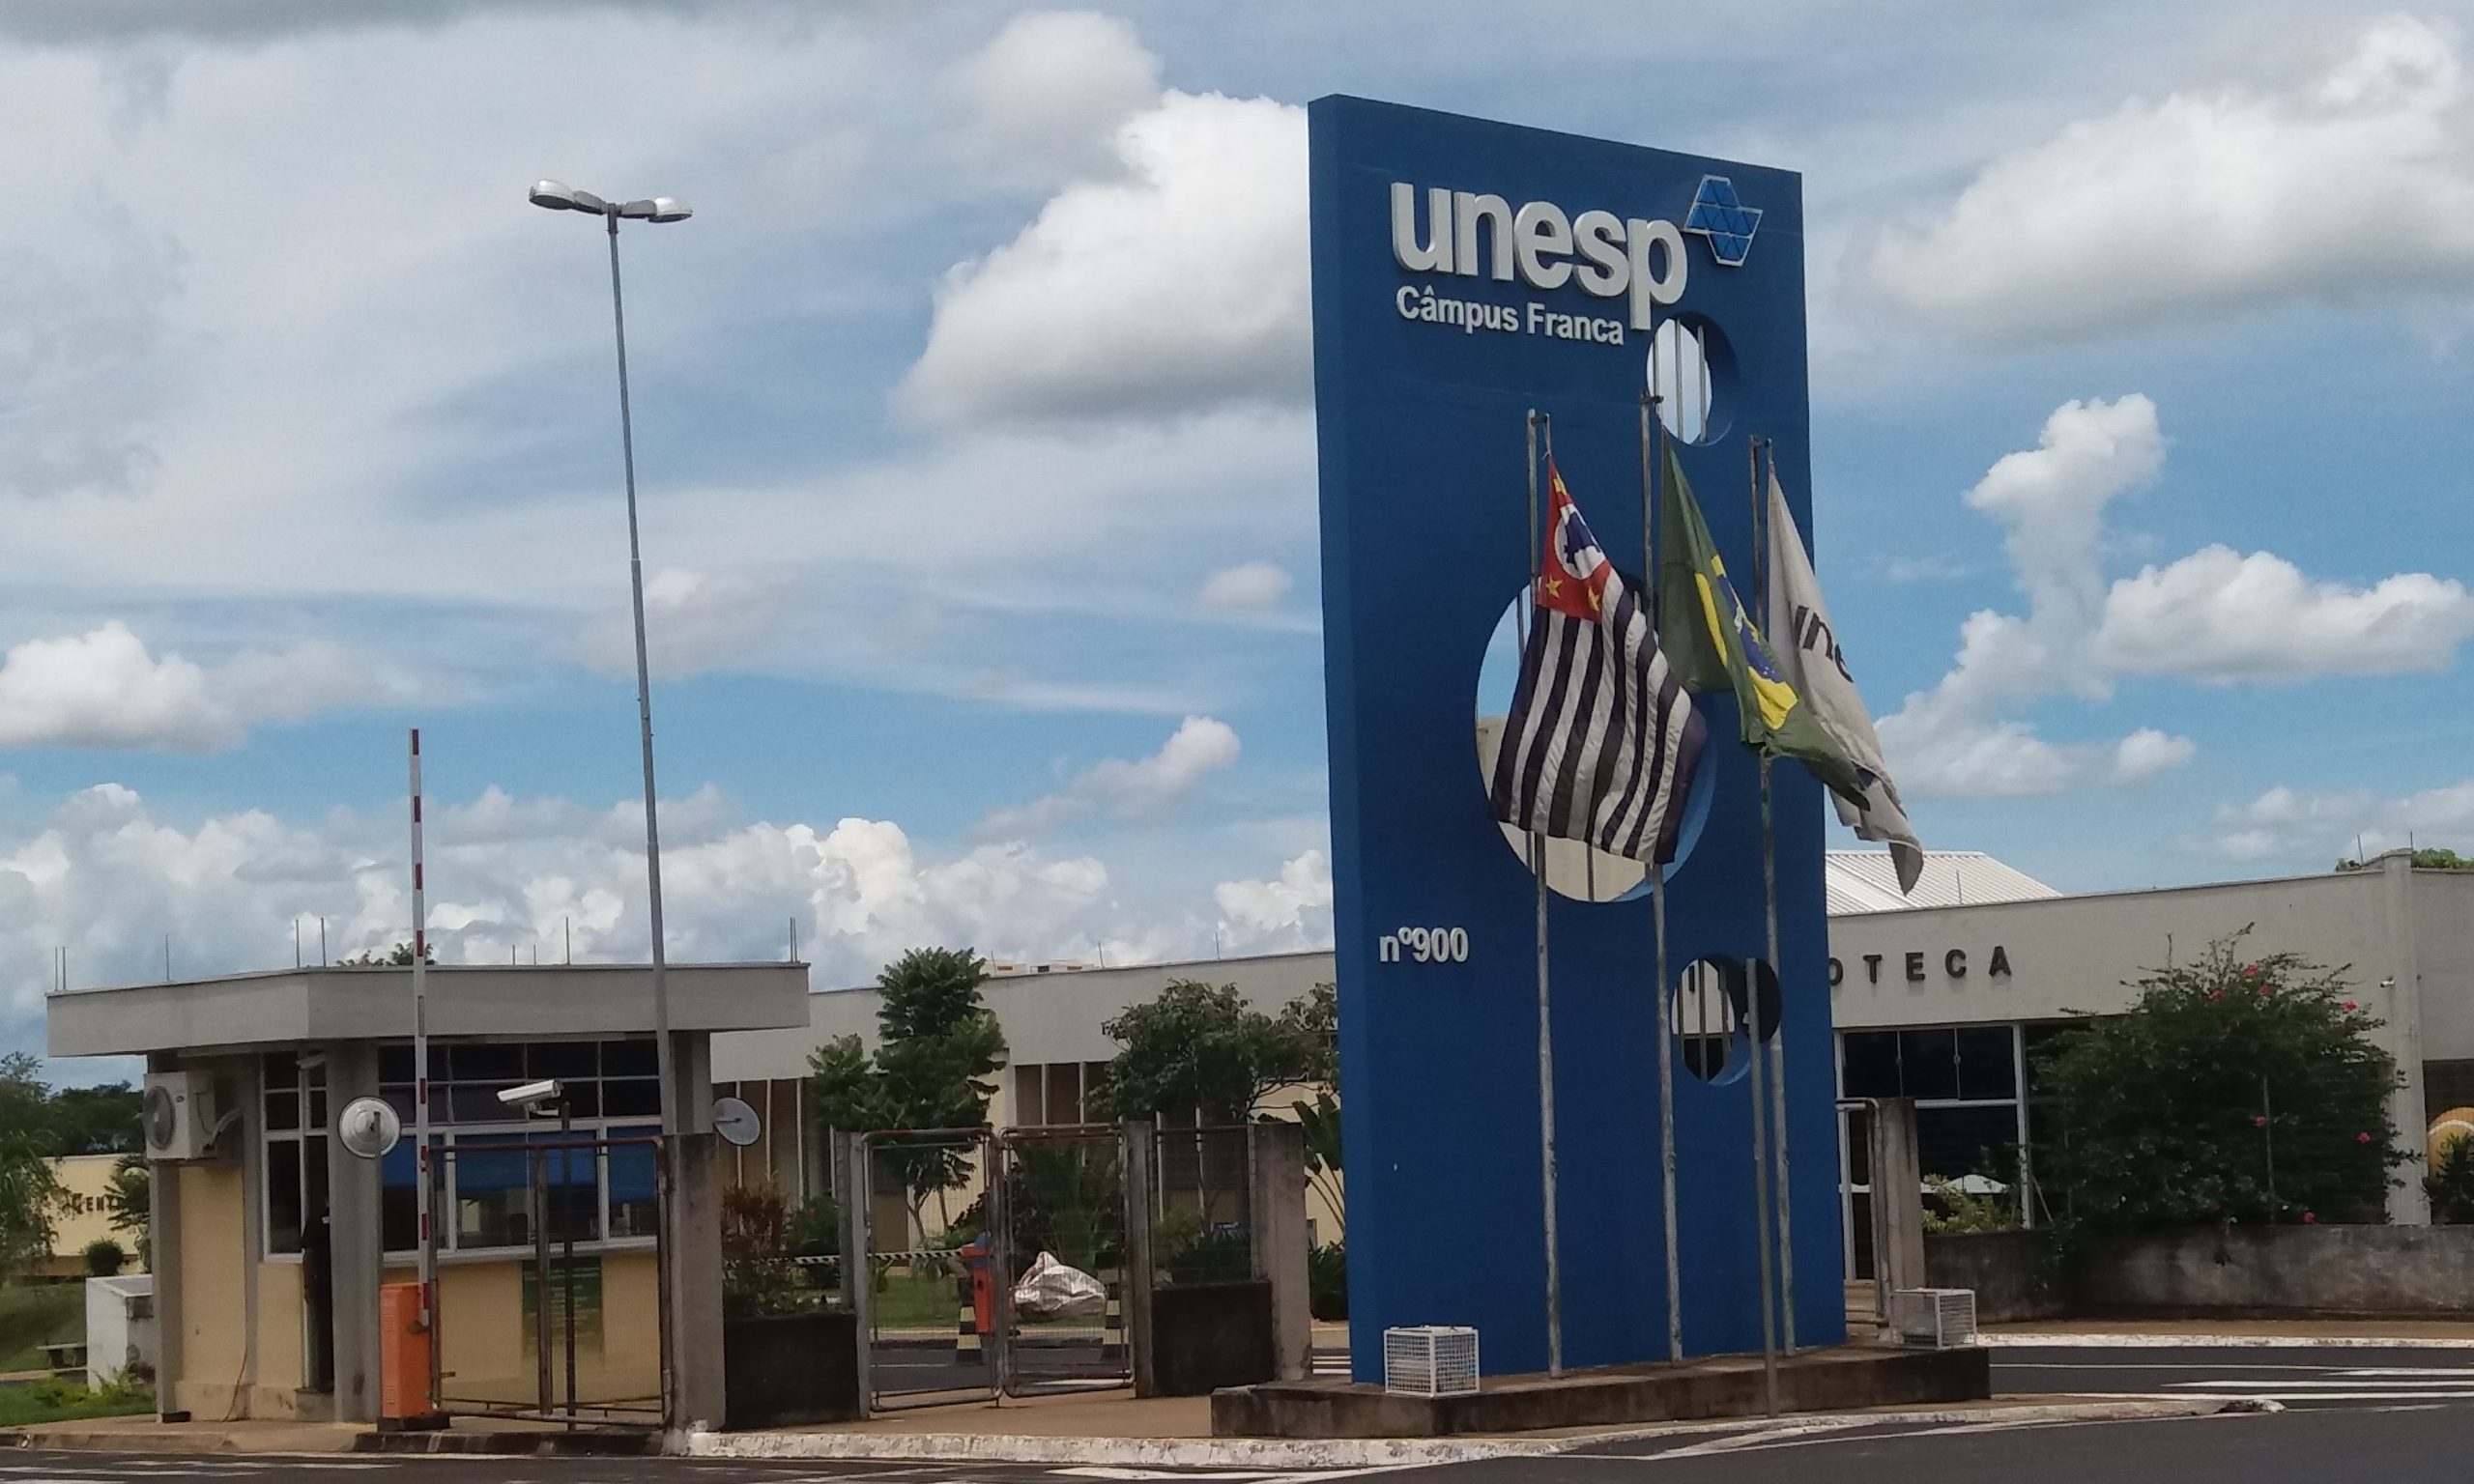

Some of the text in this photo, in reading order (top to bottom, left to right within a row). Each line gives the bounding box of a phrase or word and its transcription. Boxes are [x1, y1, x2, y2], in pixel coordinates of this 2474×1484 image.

[1392, 182, 1688, 330] unesp
[1396, 284, 1625, 346] Câmpus Franca
